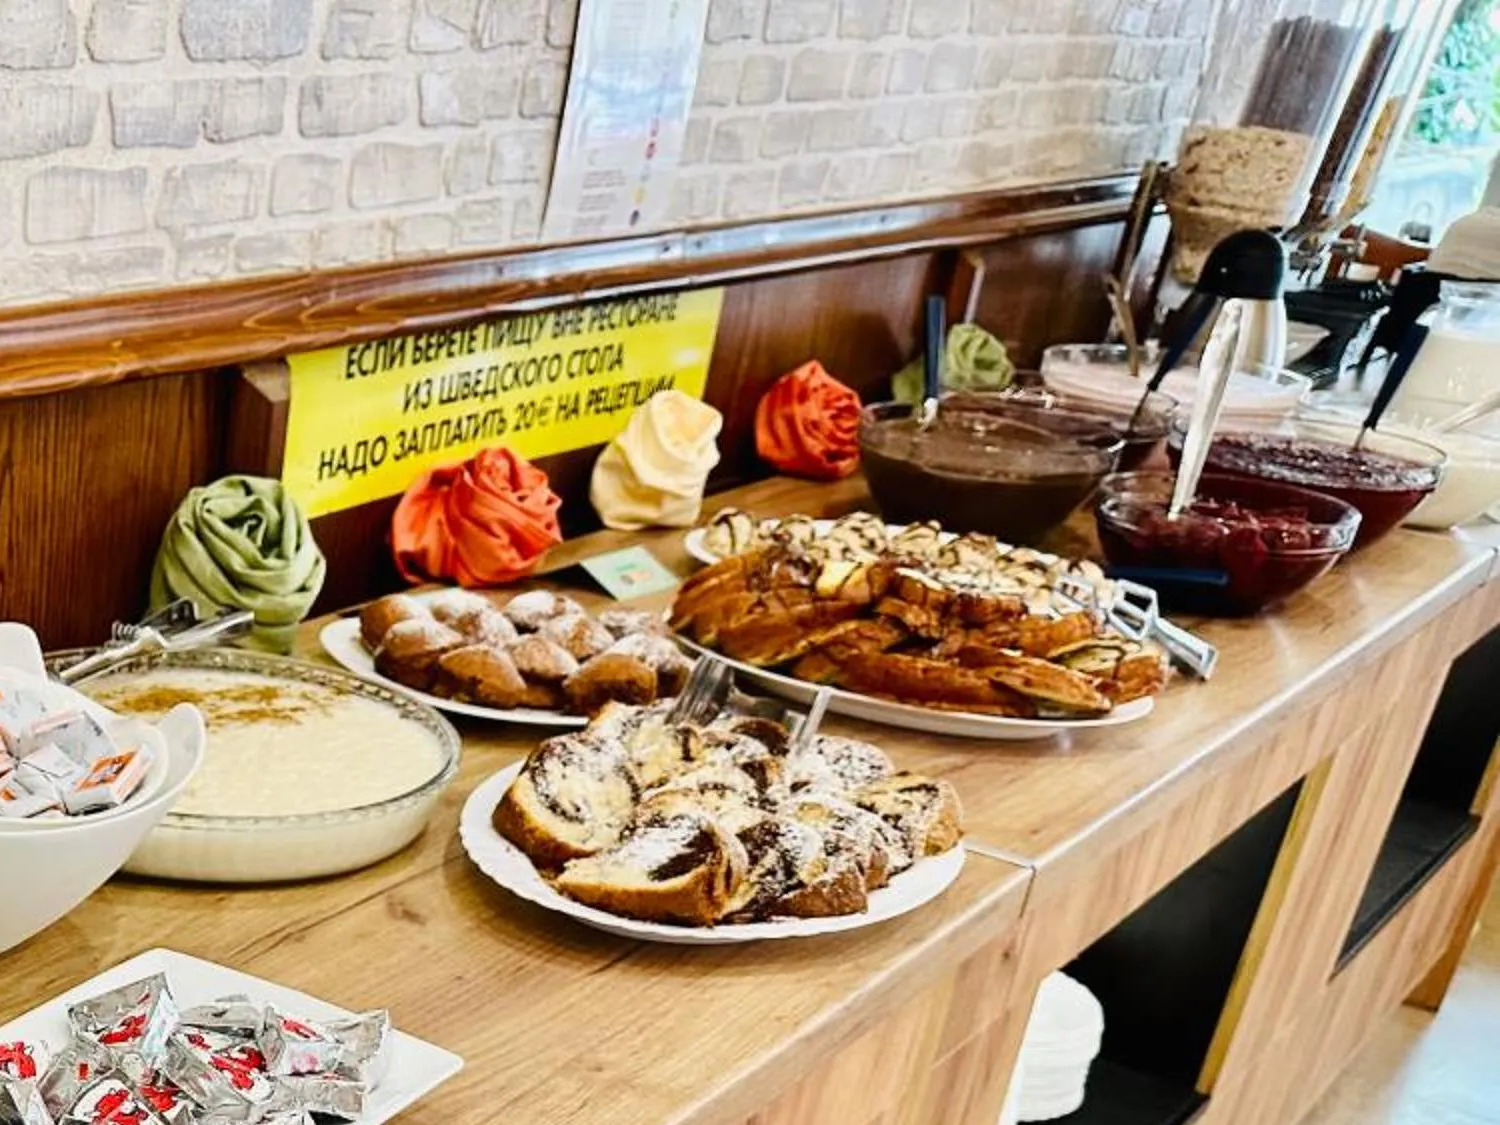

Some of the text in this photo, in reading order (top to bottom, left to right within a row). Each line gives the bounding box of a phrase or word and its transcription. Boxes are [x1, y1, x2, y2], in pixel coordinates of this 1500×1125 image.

[346, 335, 407, 379] ЕСЛИ
[411, 323, 477, 365] БЕРЕТЕ
[482, 313, 548, 352] ПИЩУ
[550, 309, 584, 339] ВНЕ
[403, 343, 624, 413] ИЗ ШВЕДСКОГО СТОЛА
[318, 435, 387, 480] НАДО
[393, 408, 507, 461] ЗАПЛАТИТЬ
[555, 392, 580, 421] НА
